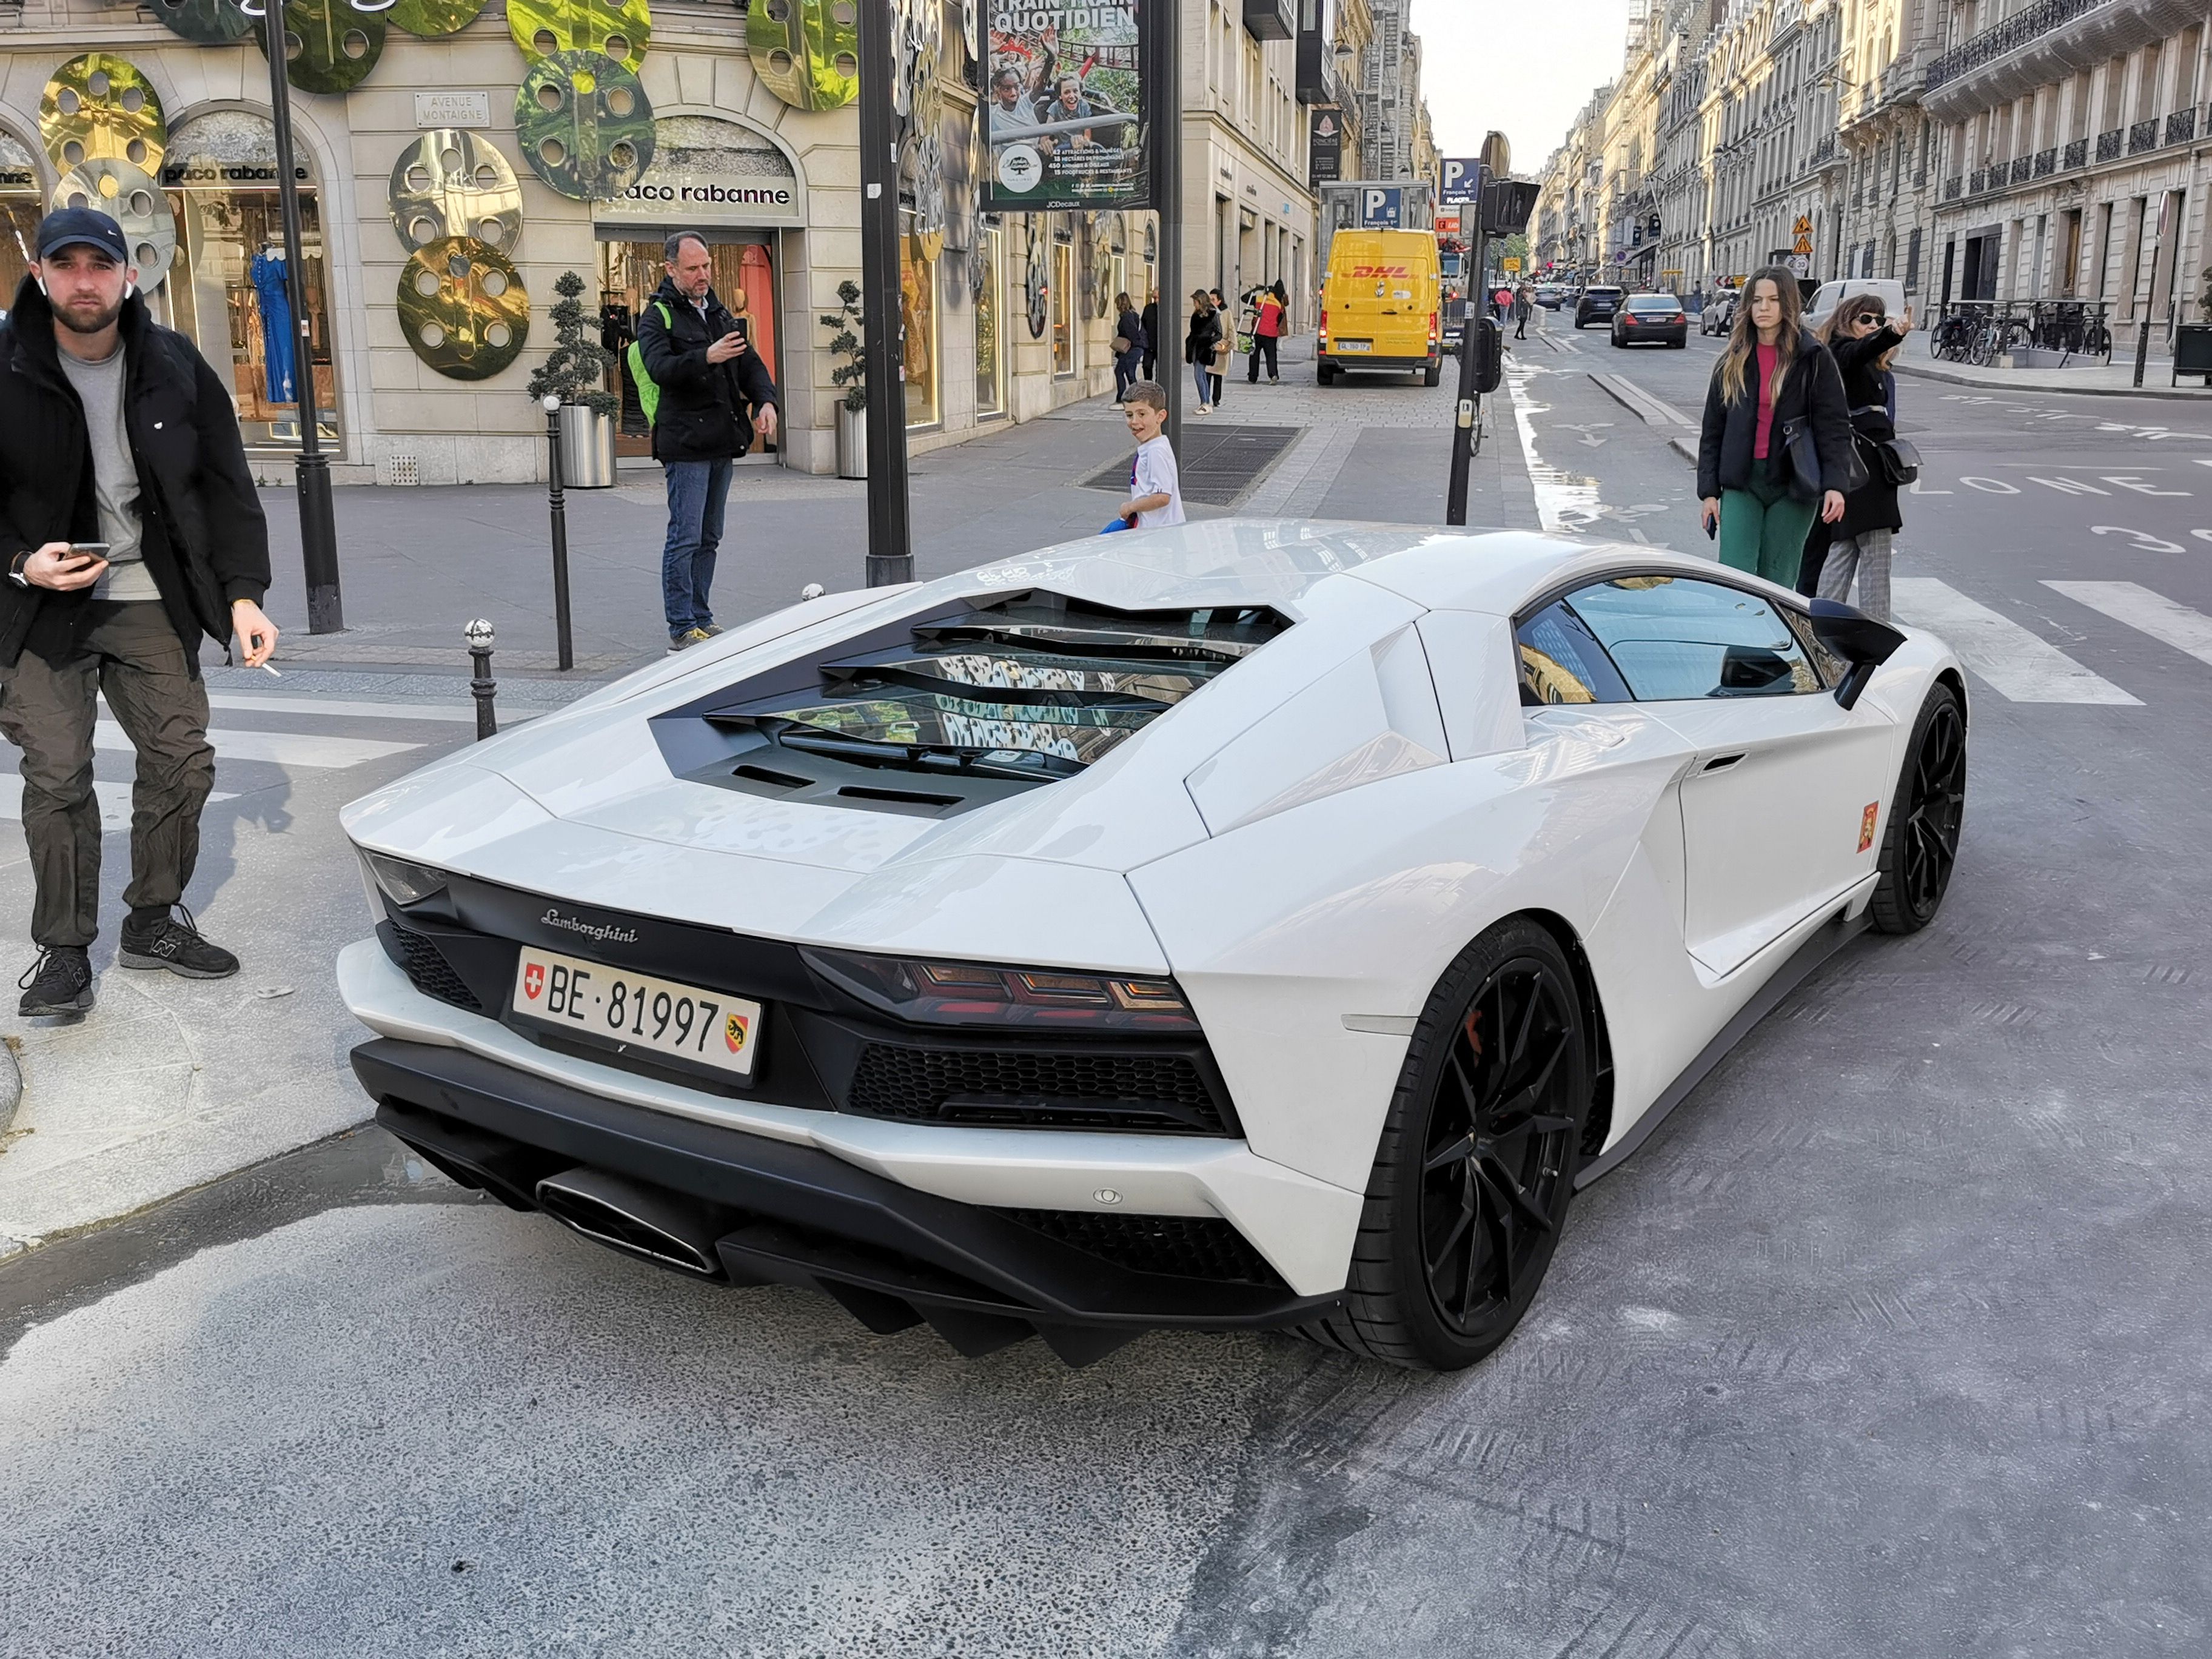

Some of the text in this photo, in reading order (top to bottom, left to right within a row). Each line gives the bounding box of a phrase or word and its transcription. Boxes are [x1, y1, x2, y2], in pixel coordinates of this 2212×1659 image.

[994, 7, 1134, 32] QUOTIDIEN
[431, 96, 472, 107] AVENUE
[423, 110, 483, 120] MONTAIGNE
[164, 166, 308, 182] paco rabane
[1445, 161, 1464, 188] P
[608, 184, 790, 204] aco rabanne
[1366, 190, 1386, 218] P
[1352, 266, 1410, 278] DHL
[540, 909, 638, 943] Lamborghini
